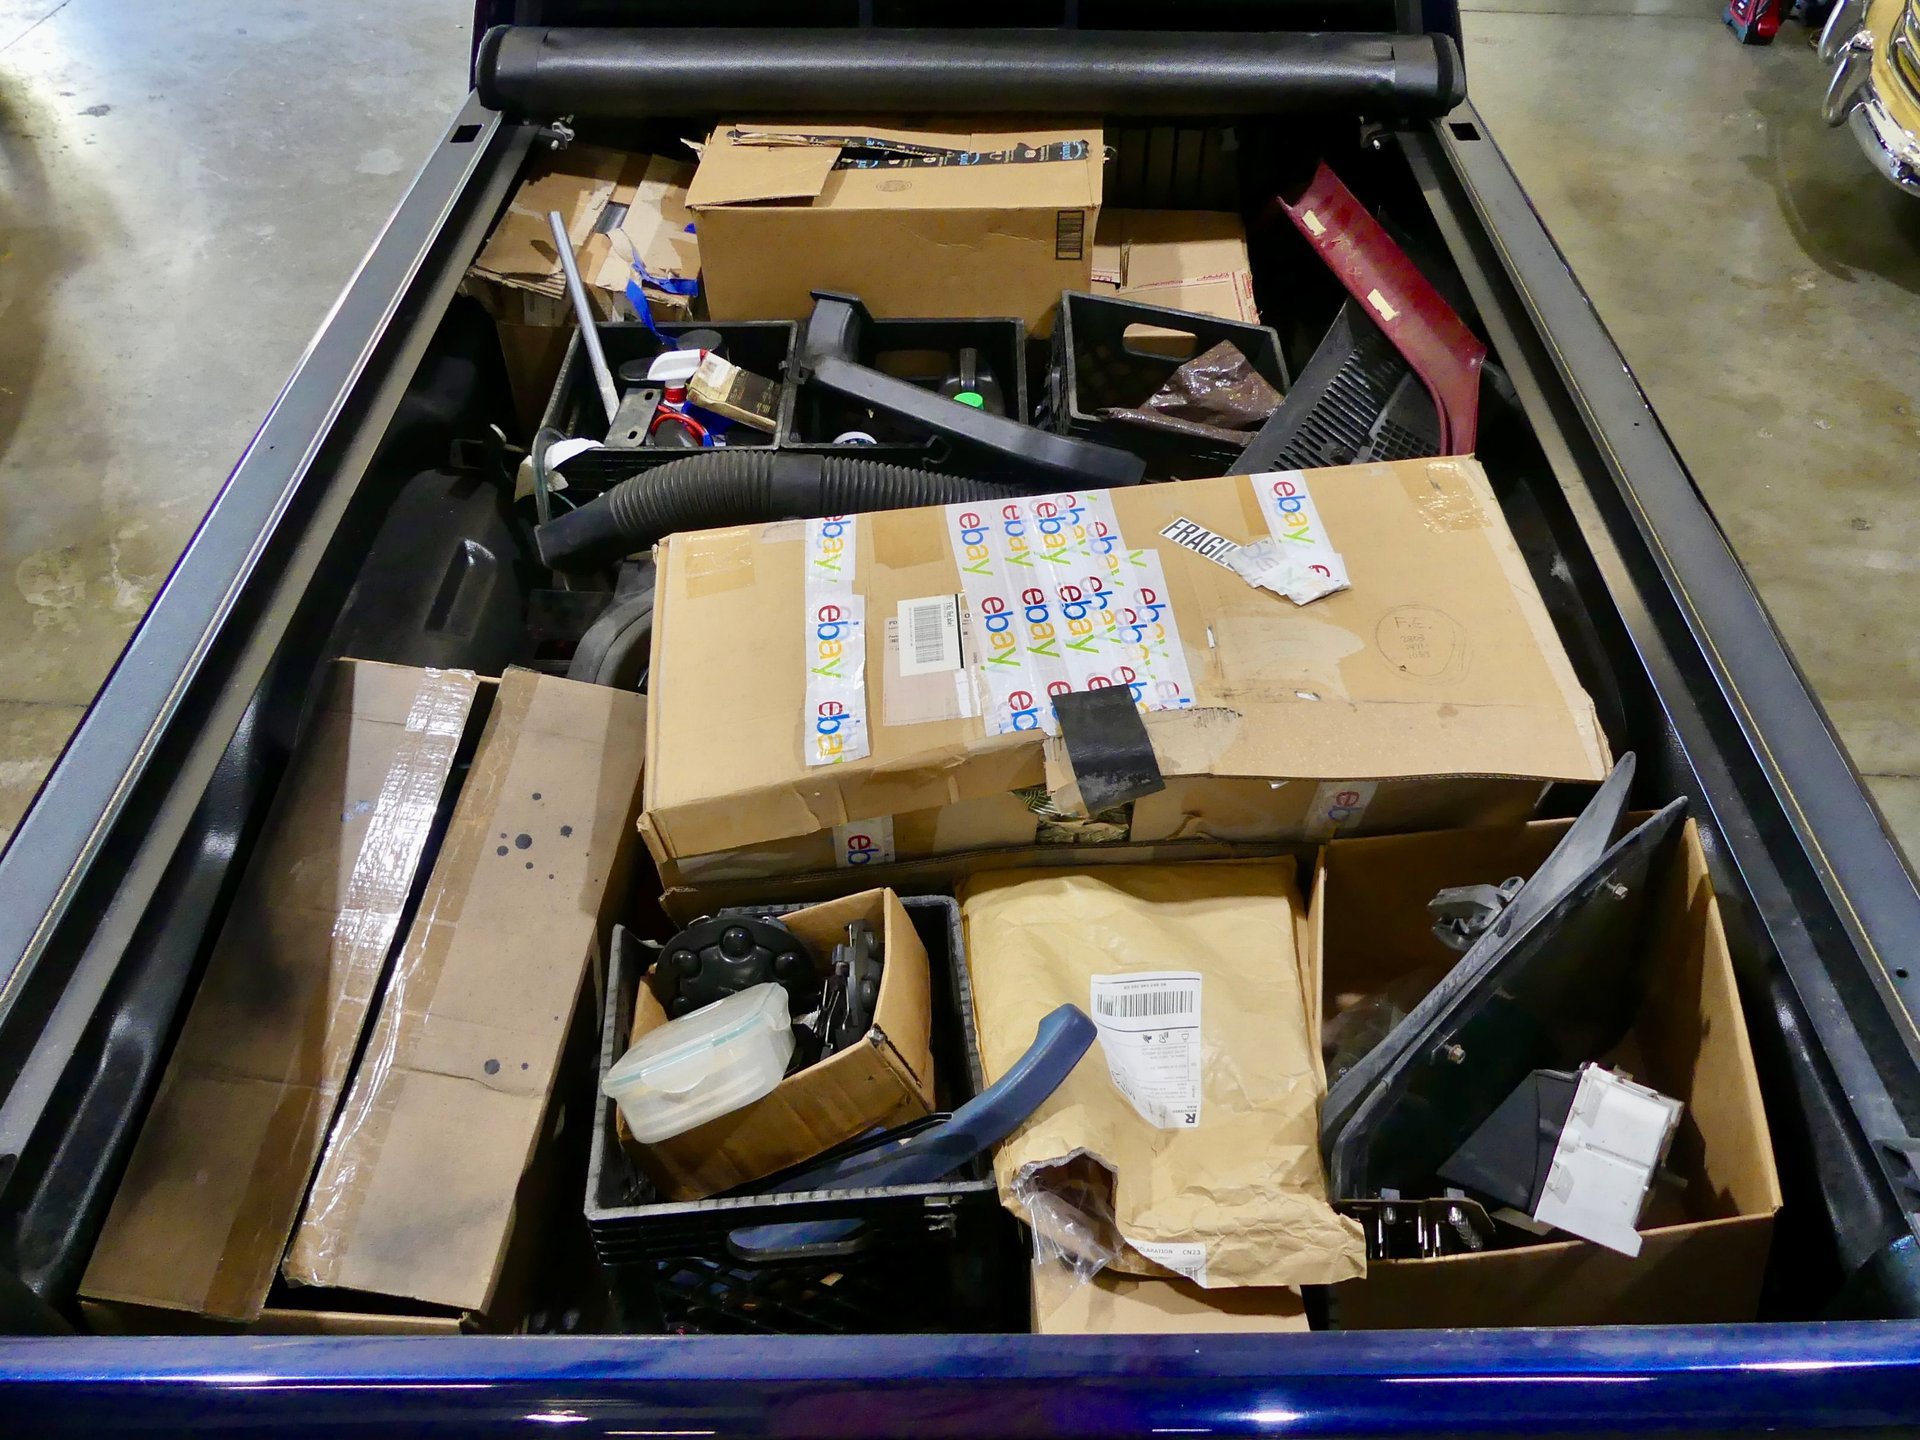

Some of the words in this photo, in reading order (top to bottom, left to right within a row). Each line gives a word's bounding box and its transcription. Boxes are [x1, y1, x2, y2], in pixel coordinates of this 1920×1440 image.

[959, 512, 994, 576] ebay
[1001, 504, 1034, 567] ebay
[1036, 501, 1071, 565] ebay
[1161, 518, 1238, 570] FRAGIL
[1273, 480, 1316, 545] ebay
[811, 604, 849, 679] ebay
[981, 596, 1021, 667] ebay
[1022, 587, 1060, 658] ebay
[1060, 585, 1099, 653] ebay
[816, 701, 850, 764] eba
[848, 834, 879, 865] eb
[1185, 1112, 1196, 1124] R
[1182, 1248, 1201, 1256] CN23
